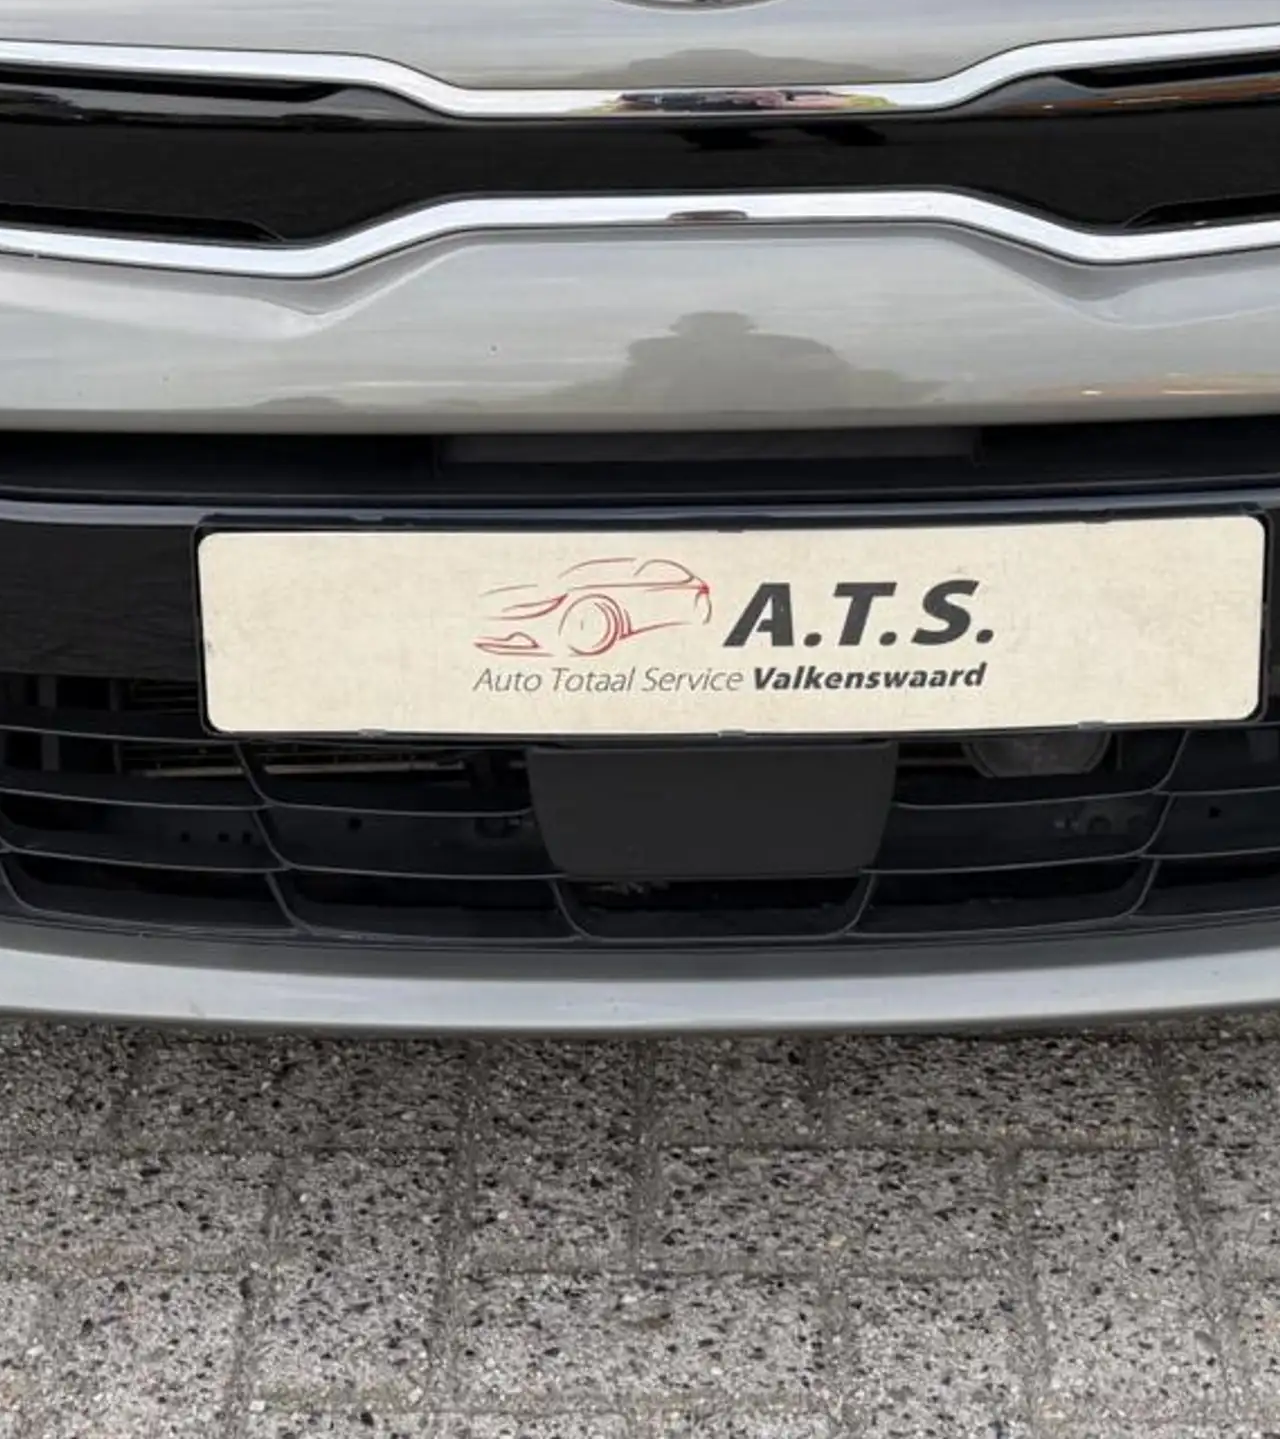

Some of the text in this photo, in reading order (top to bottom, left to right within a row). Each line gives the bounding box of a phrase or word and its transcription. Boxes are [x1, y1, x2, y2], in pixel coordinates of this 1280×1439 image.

[722, 579, 995, 648] A.T.S.
[472, 661, 988, 693] Auto Totaal Service Valkenswaard
